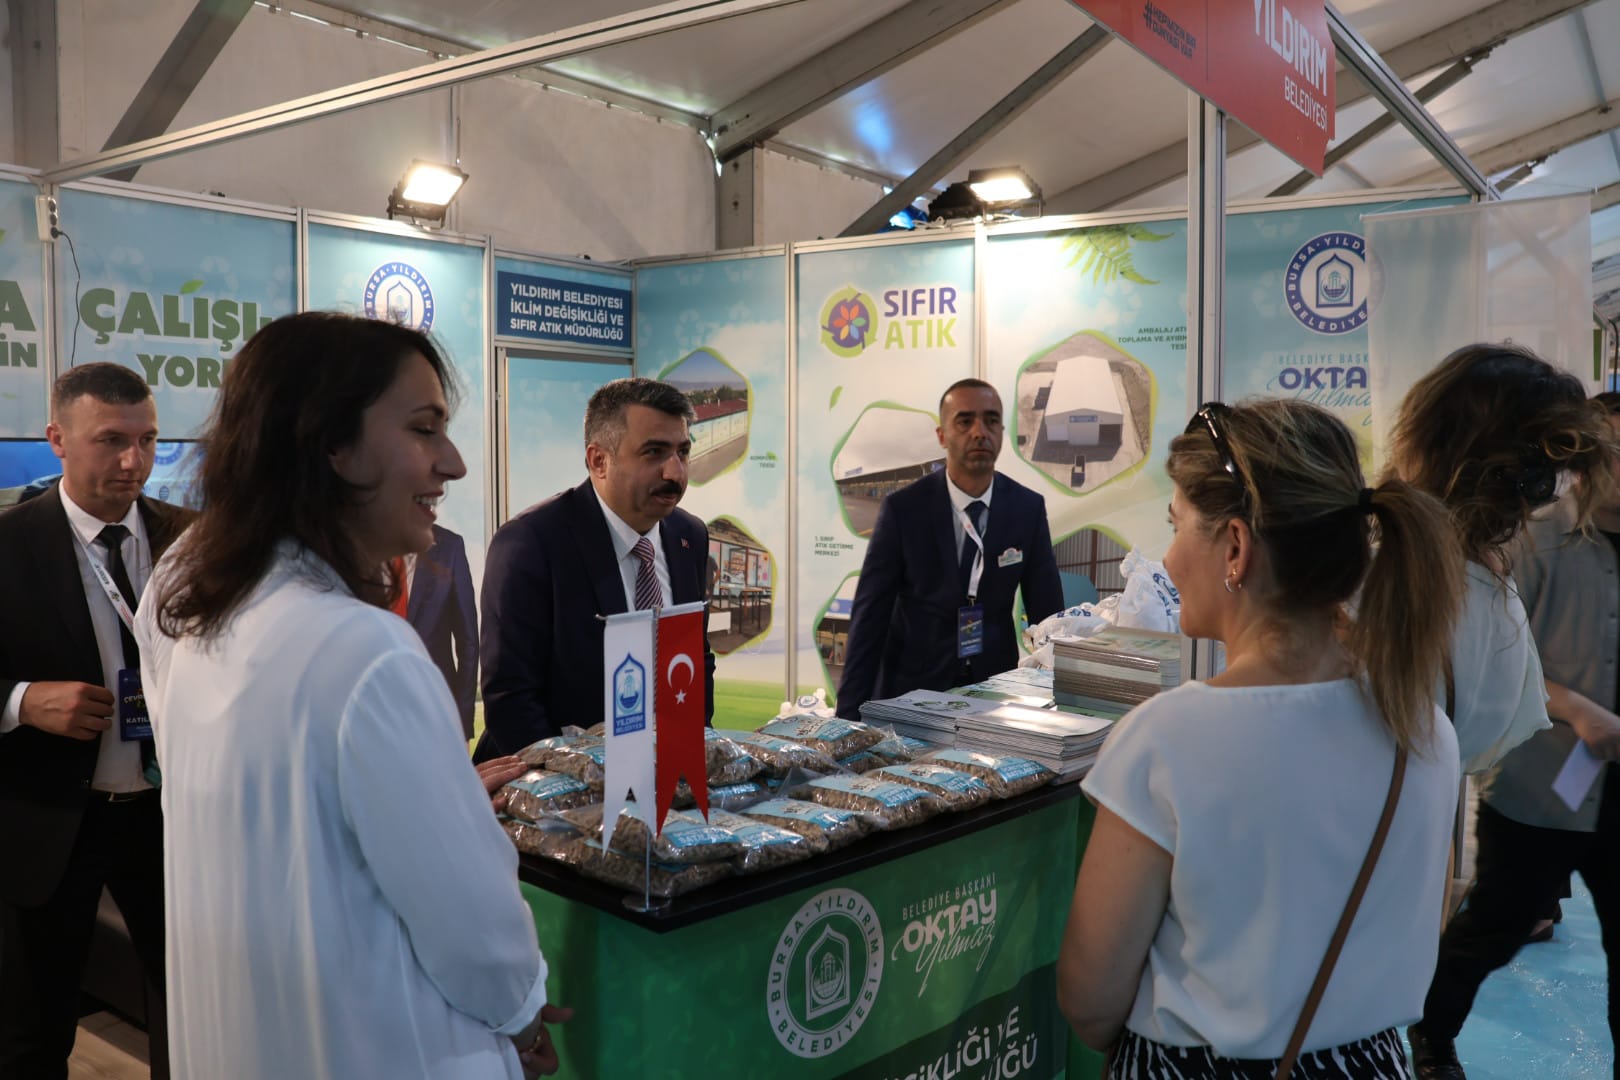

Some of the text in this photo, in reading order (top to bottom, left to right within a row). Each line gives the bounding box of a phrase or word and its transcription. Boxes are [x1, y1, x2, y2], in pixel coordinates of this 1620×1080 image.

[1254, 0, 1327, 97] YILDIRIM
[1285, 76, 1328, 132] BELEDİYESİ
[1288, 246, 1315, 291] BURSA
[391, 264, 432, 309] YILDIRIM
[510, 282, 623, 309] YILDIRIM BELEDİYESİ
[884, 287, 956, 317] SIFIR
[510, 298, 624, 326] İKLİM DEĞİŞİKLİĞİ VE
[510, 318, 624, 341] SIFIR ATIK MÜDÜRLÜĞÜ
[884, 318, 956, 350] ATIK
[1118, 335, 1152, 343] TOPLAMA
[1279, 366, 1367, 390] OKTA
[955, 872, 996, 900] BAŞKANI
[903, 888, 998, 953] OKTAY
[771, 895, 879, 1003] BURSA YILDIRIM
